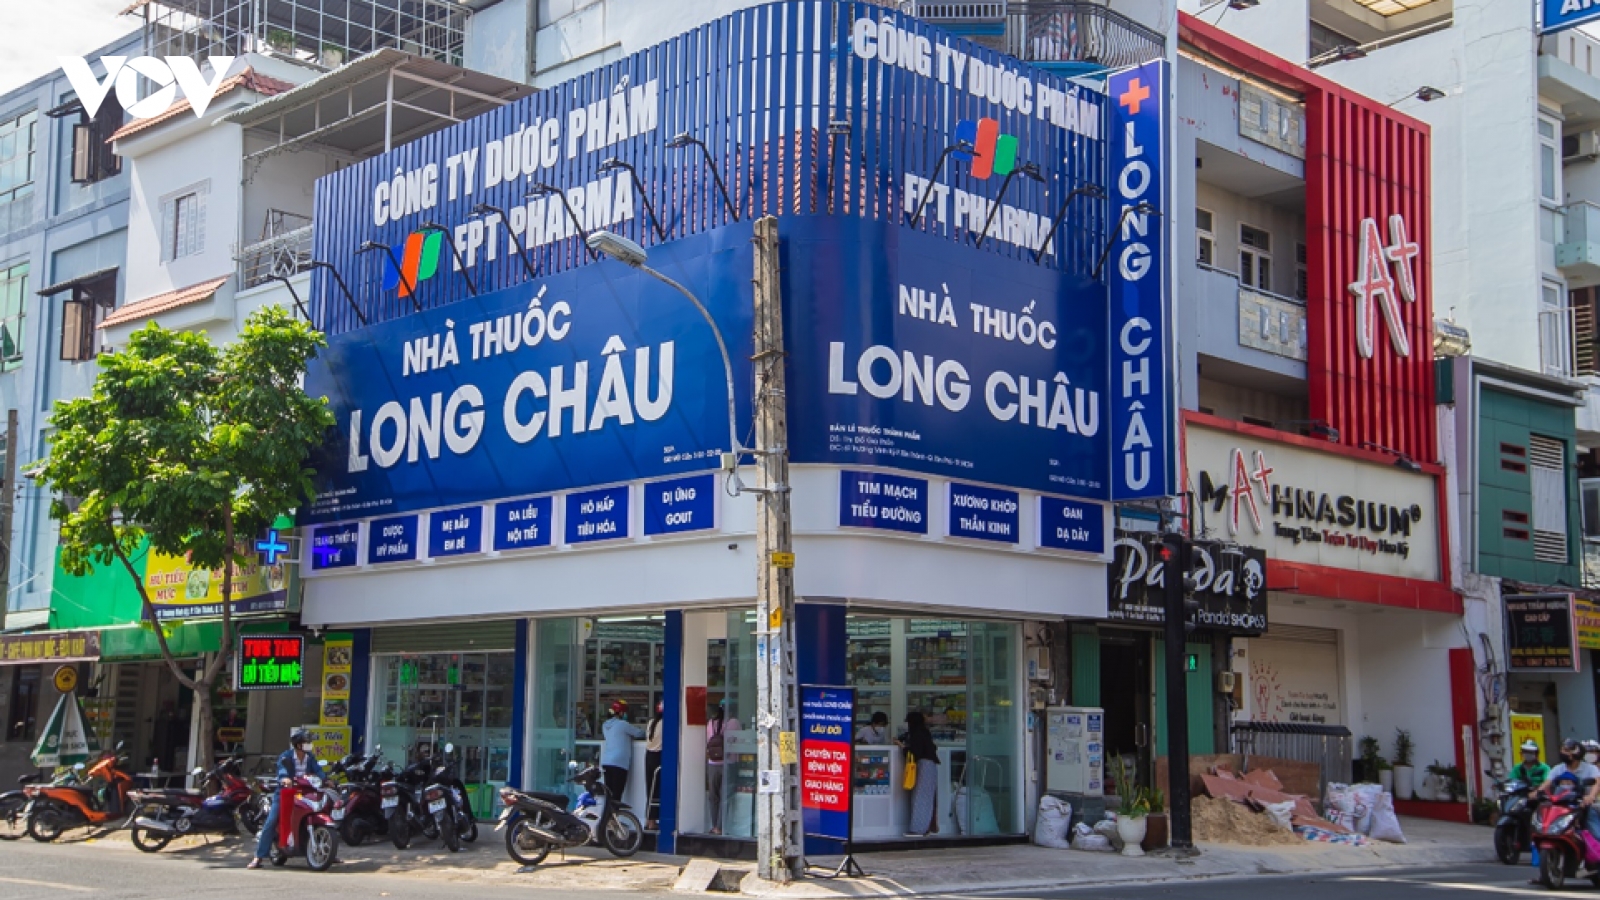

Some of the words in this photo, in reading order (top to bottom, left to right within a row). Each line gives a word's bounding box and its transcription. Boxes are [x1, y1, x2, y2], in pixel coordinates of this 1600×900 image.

[853, 16, 931, 78] CÔNG
[936, 36, 966, 91] TY
[968, 54, 1032, 116] DƯỢC
[1037, 82, 1098, 140] PHẨM
[374, 164, 438, 227] CÔNG
[446, 148, 477, 201] TY
[485, 116, 560, 189] DƯỢC
[568, 75, 659, 158] PHẨM
[1118, 121, 1152, 281] LONG
[453, 210, 501, 272] FPT
[509, 170, 635, 256] PHARMA
[904, 172, 950, 225] FPT
[954, 187, 1055, 256] PHARMA
[899, 282, 958, 328] NHÀ
[970, 299, 1057, 350] THUỐC
[403, 318, 459, 378] NHÀ
[469, 284, 571, 361] THUỐC
[828, 341, 972, 413] LONG
[985, 371, 1099, 438] CHÂU
[347, 384, 485, 474] LONG
[503, 334, 674, 445] CHÂU
[1119, 317, 1153, 491] CHÂU
[662, 491, 672, 506] DỊ
[675, 487, 696, 502] ỨNG
[858, 481, 880, 495] TIM
[884, 483, 917, 500] MẠCH
[581, 502, 595, 514] HÔ
[596, 495, 614, 513] HẤP
[852, 499, 878, 518] TIỂU
[881, 504, 921, 524] ĐƯỜNG
[954, 494, 988, 511] XƯƠNG
[991, 496, 1017, 514] KHỚP
[1063, 507, 1083, 520] GAN
[442, 520, 452, 533] MẸ
[454, 514, 470, 530] BẦU
[508, 510, 521, 522] DA
[666, 511, 692, 525] GOUT
[960, 514, 986, 534] THẦN
[988, 520, 1010, 535] KINH
[383, 523, 404, 538] DƯỢC
[507, 529, 522, 544] NỘI
[524, 525, 539, 540] TIẾT
[578, 520, 595, 536] TIÊU
[597, 519, 616, 534] HÓA
[1057, 528, 1069, 544] DẠ
[1071, 528, 1089, 541] DÀY
[1198, 608, 1230, 625] Panda
[805, 748, 831, 760] CHUYÊN
[808, 760, 826, 773] BỆNH
[826, 762, 842, 775] VIỆN
[805, 780, 822, 790] GIAO
[823, 781, 844, 792] HÀNG
[810, 790, 824, 804] TẬN
[824, 794, 838, 804] NƠI
